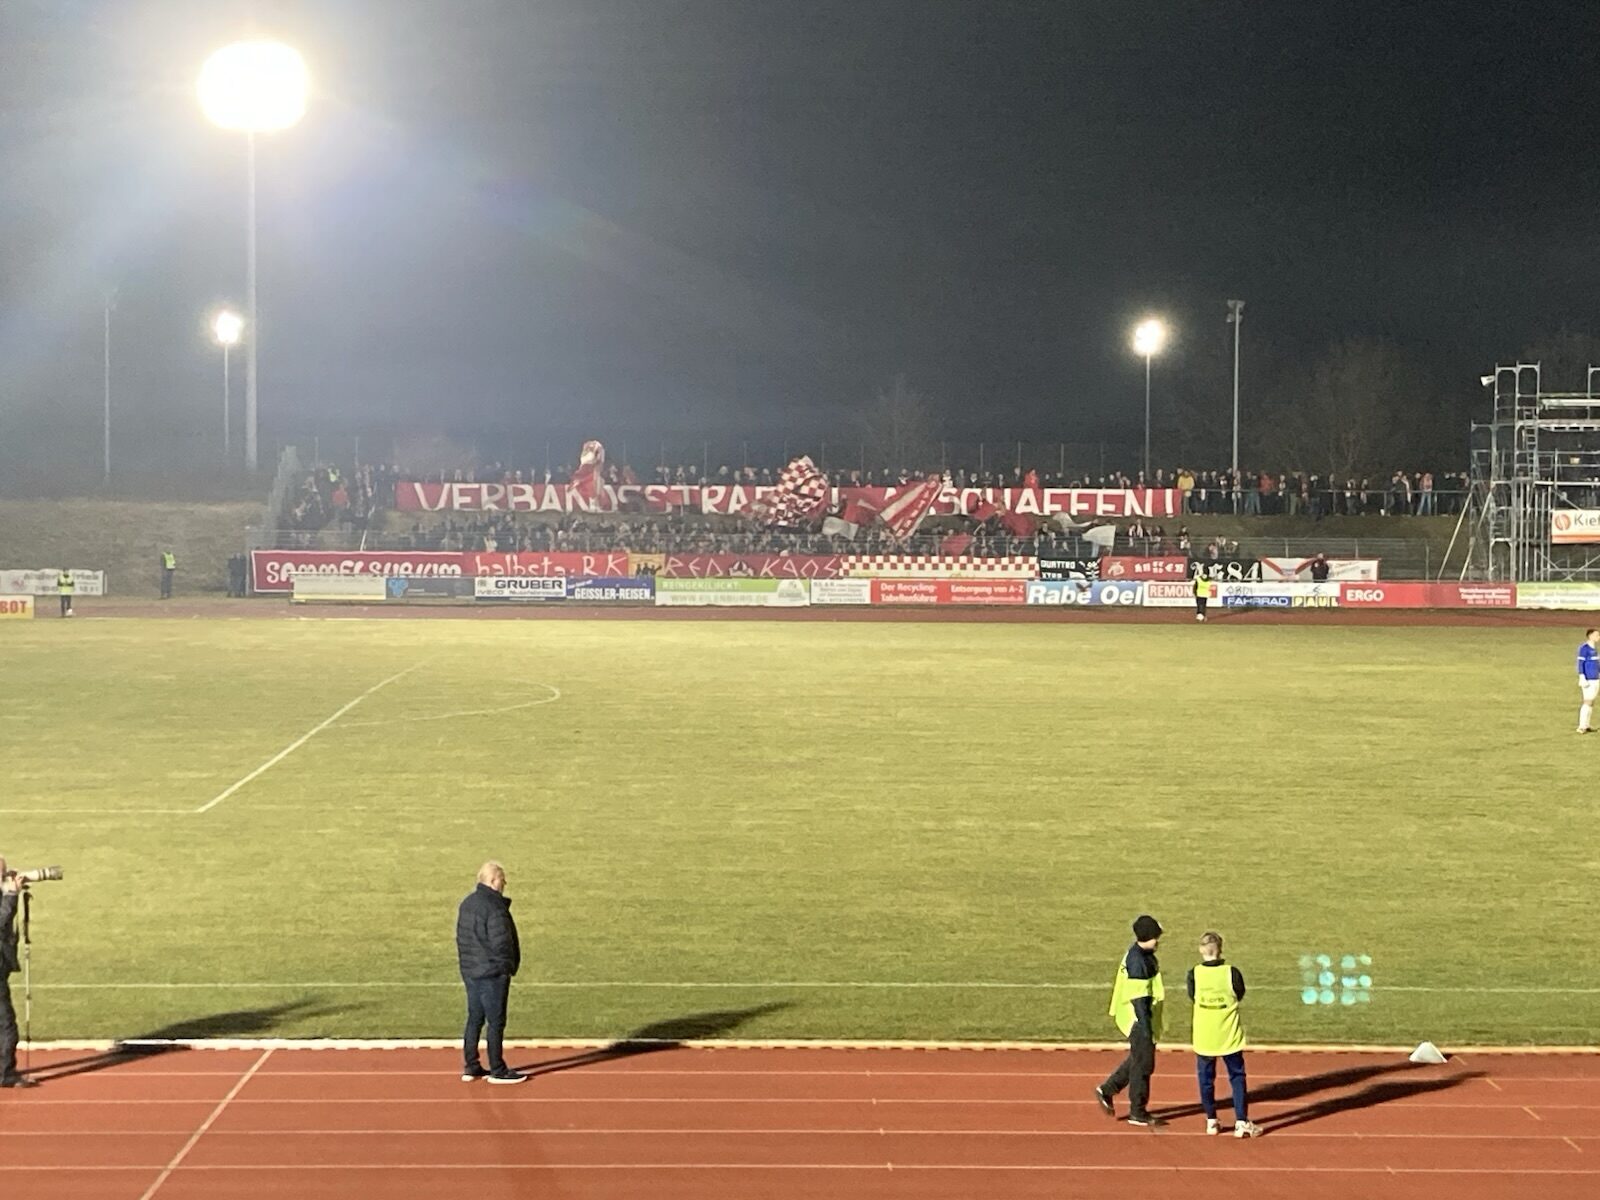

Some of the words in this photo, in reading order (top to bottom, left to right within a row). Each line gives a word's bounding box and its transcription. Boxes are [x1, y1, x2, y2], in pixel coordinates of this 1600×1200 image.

[495, 579, 563, 590] GRUBER
[880, 582, 895, 591] Der
[1008, 585, 1024, 593] A-Z
[1027, 584, 1092, 605] Rabe
[1100, 584, 1143, 605] Oel
[1346, 589, 1385, 602] ERGO
[1226, 597, 1289, 606] FAHRRAD
[1293, 596, 1340, 607] PAUL
